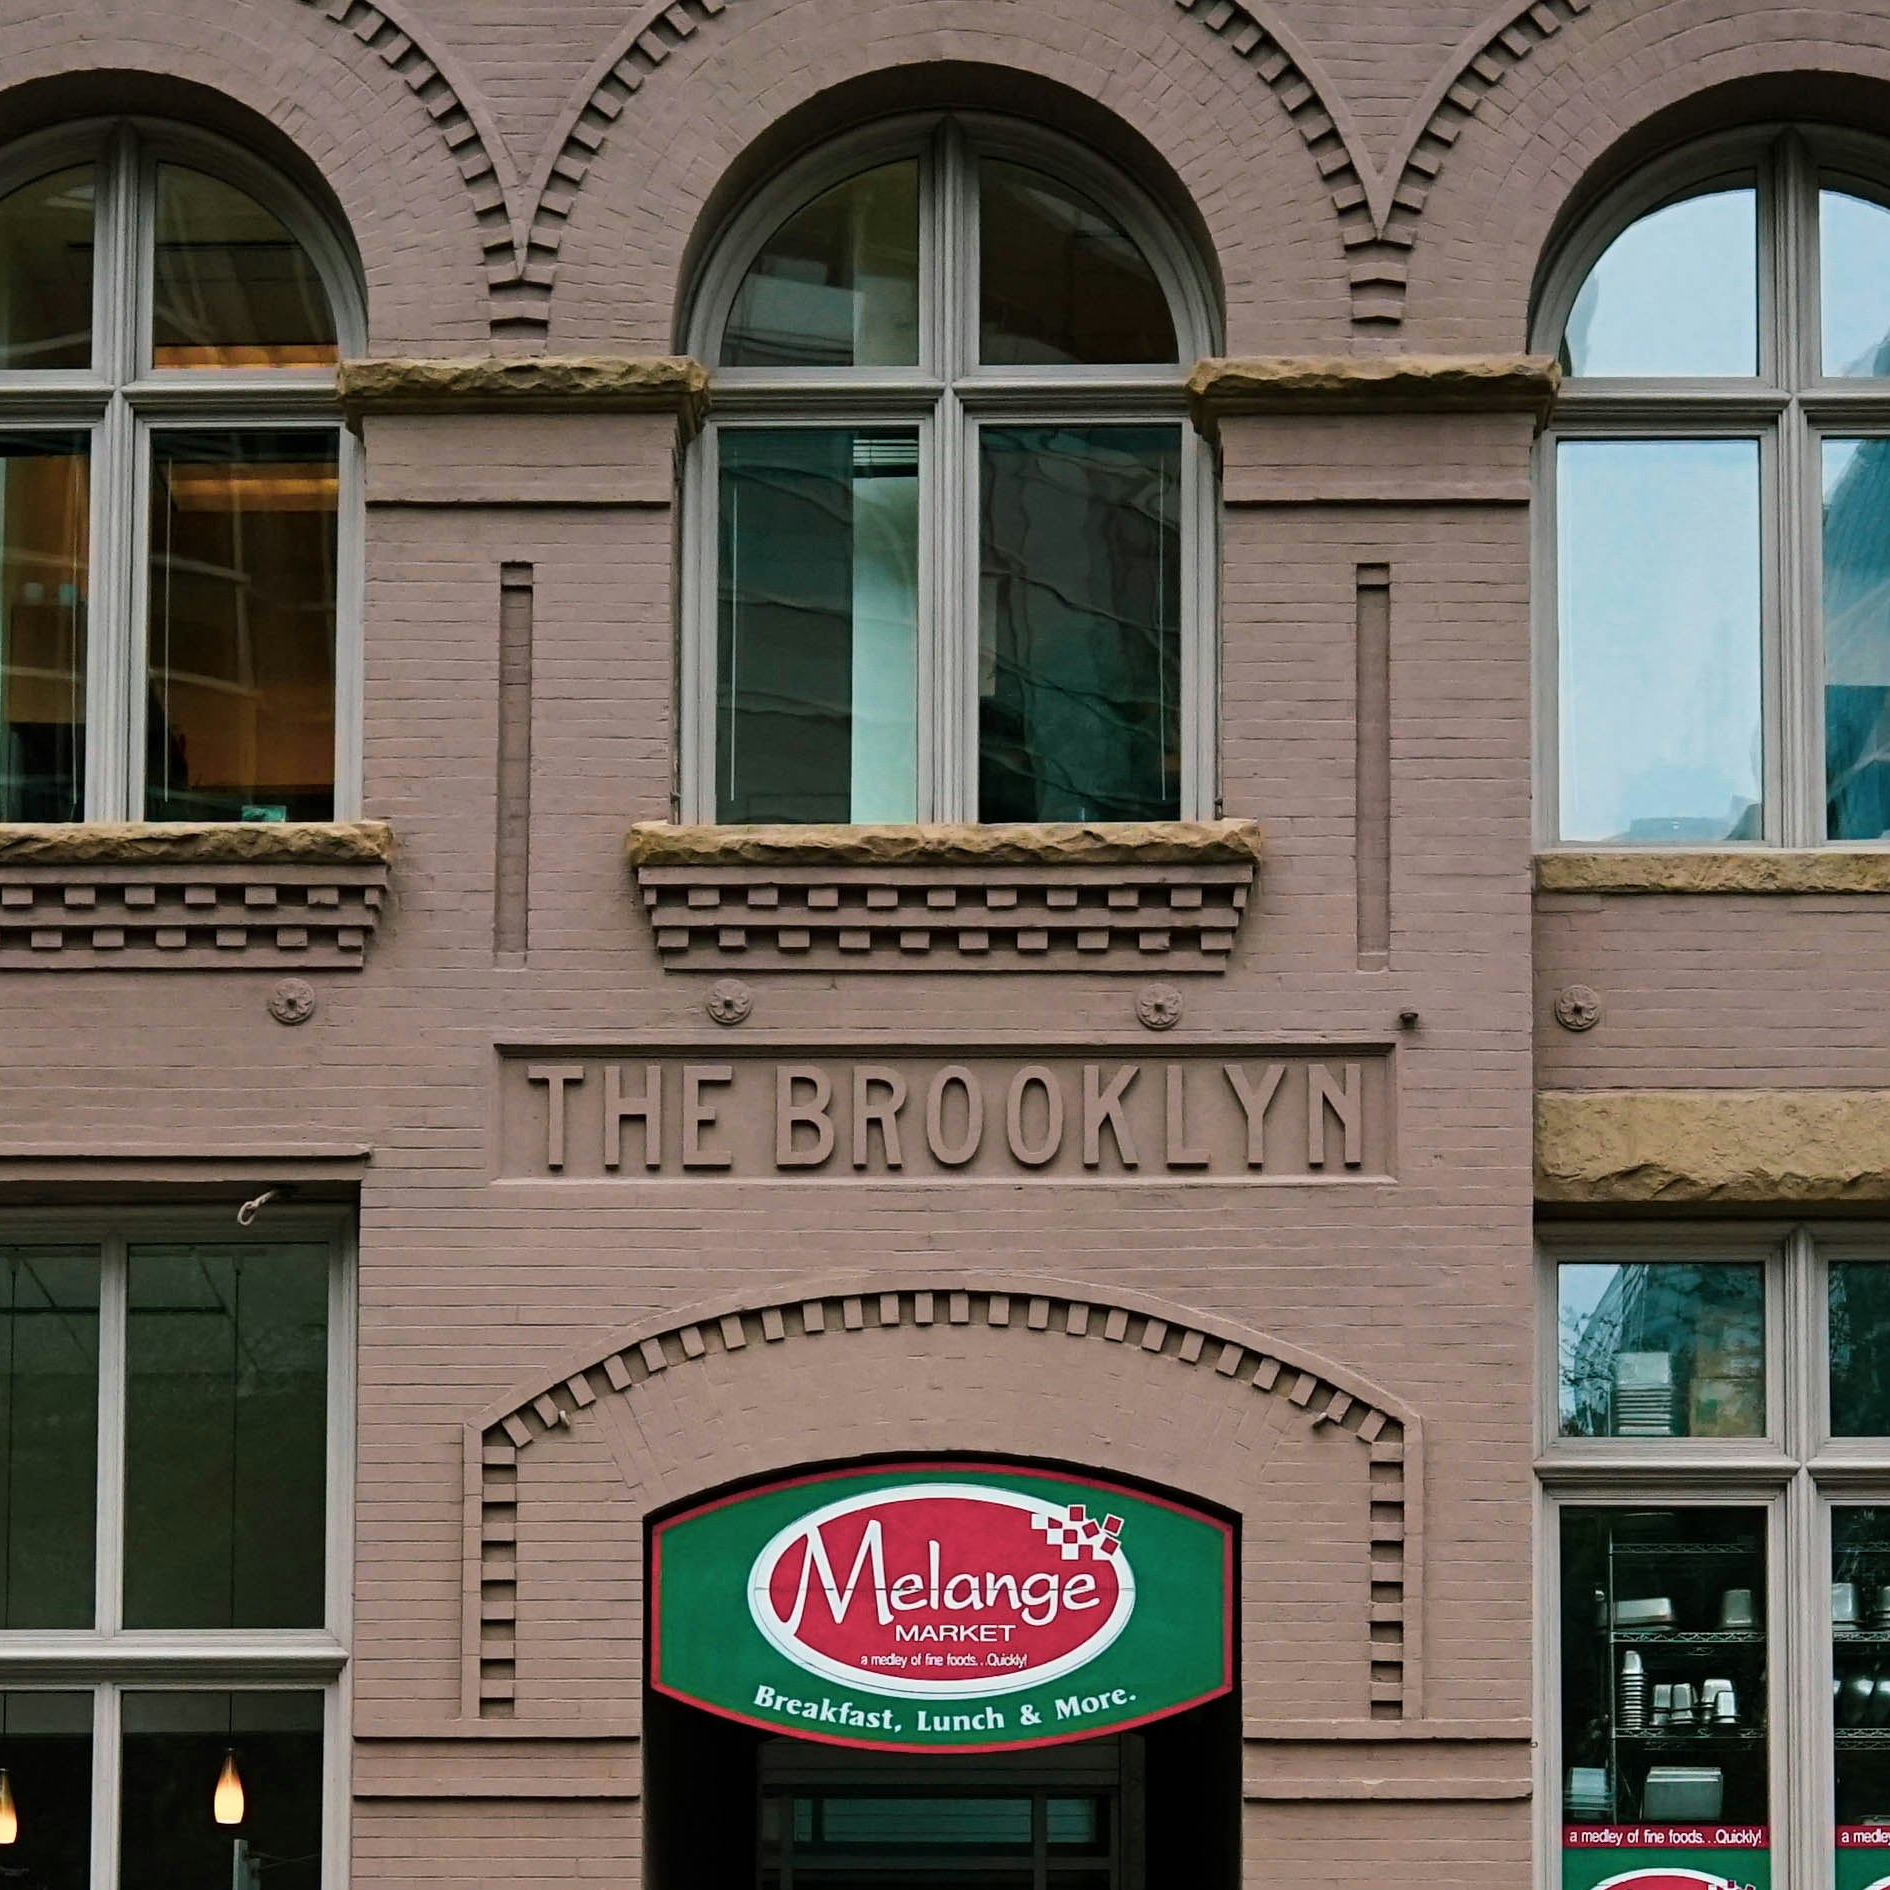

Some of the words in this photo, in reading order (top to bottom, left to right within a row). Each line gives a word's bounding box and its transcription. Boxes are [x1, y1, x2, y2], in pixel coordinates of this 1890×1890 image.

[527, 1063, 735, 1170] THE
[773, 1062, 1364, 1171] BROOKLYN
[784, 1518, 1102, 1627] Melange
[894, 1624, 1017, 1642] MARKET
[861, 1655, 868, 1666] a
[871, 1653, 908, 1669] medley
[911, 1653, 921, 1666] of
[925, 1653, 945, 1666] fine
[753, 1684, 903, 1734] Breakfast,
[917, 1706, 1005, 1732] Lunch
[1020, 1704, 1042, 1726] &
[1055, 1687, 1138, 1721] More.
[1569, 1831, 1577, 1843] a
[1581, 1829, 1623, 1846] medley
[1627, 1829, 1640, 1843] of
[1644, 1829, 1665, 1843] fine
[1841, 1831, 1850, 1843] a
